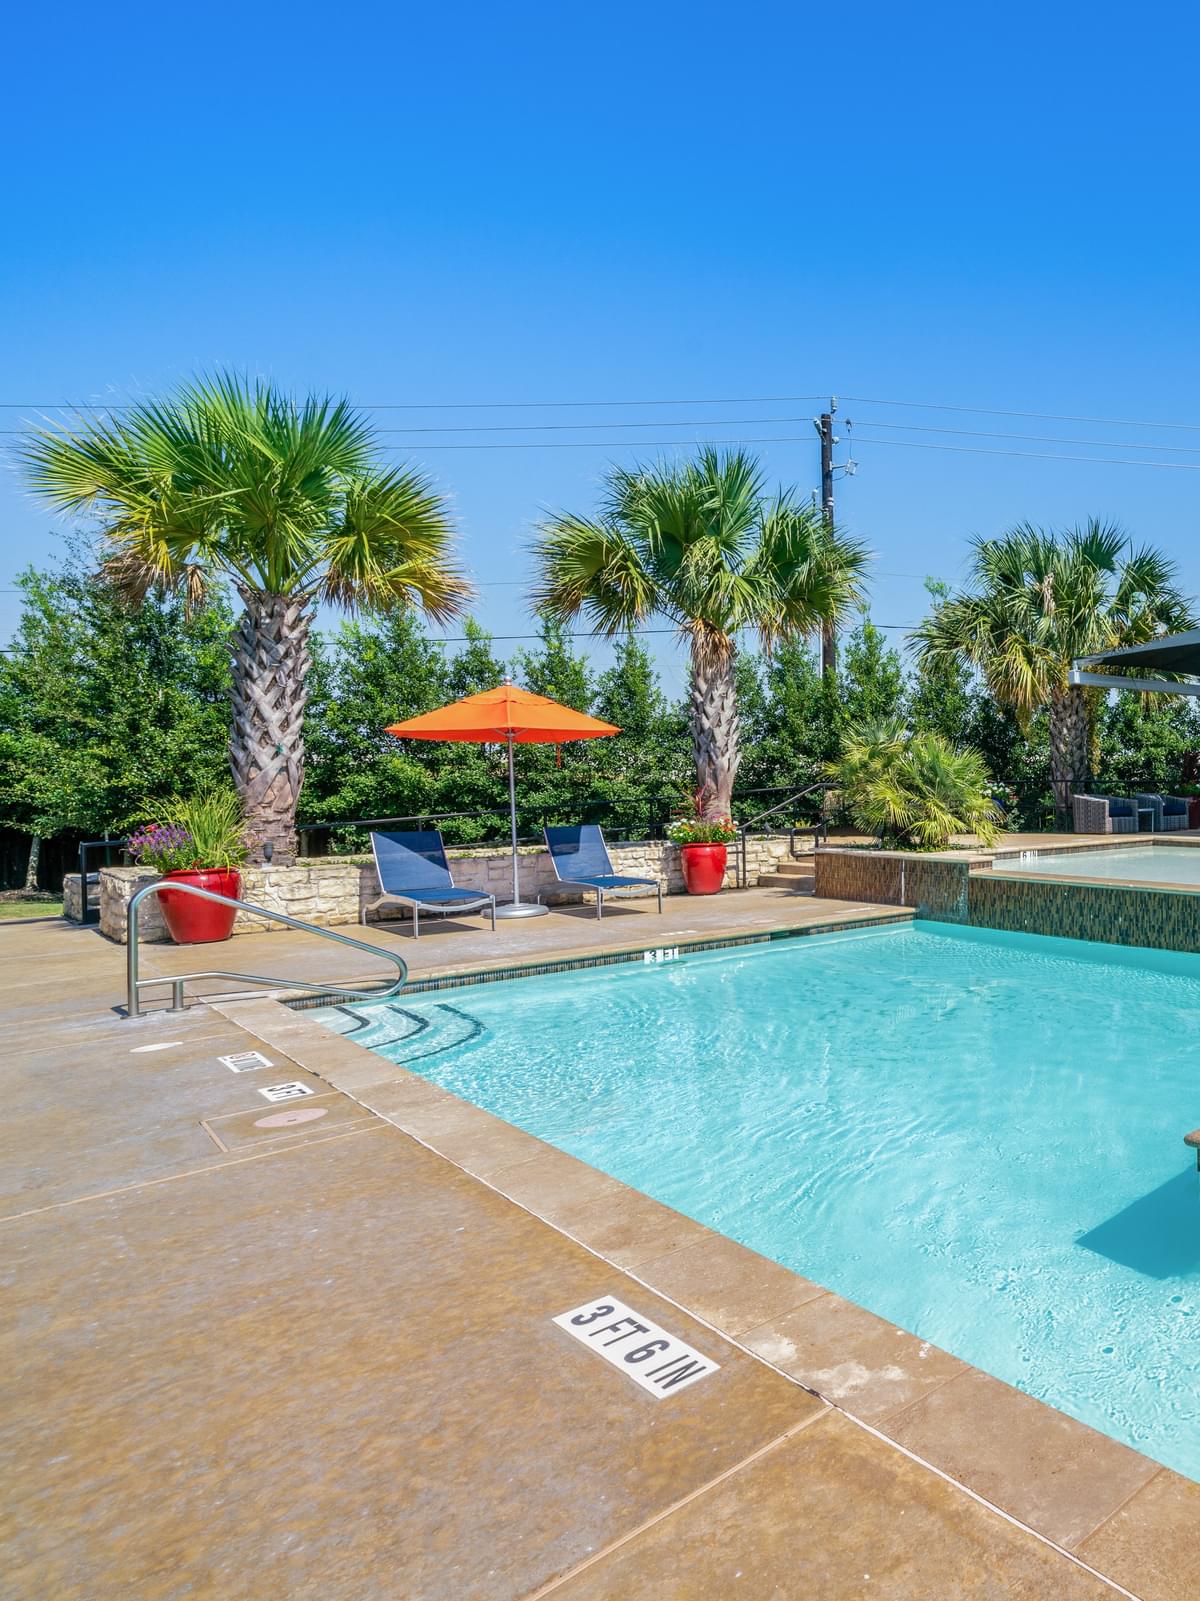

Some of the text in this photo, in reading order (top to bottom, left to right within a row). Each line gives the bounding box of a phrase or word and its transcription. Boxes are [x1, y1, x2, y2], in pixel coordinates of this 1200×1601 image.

[267, 1084, 307, 1099] 3 FT
[570, 1304, 707, 1390] 3 FT 6 IN
